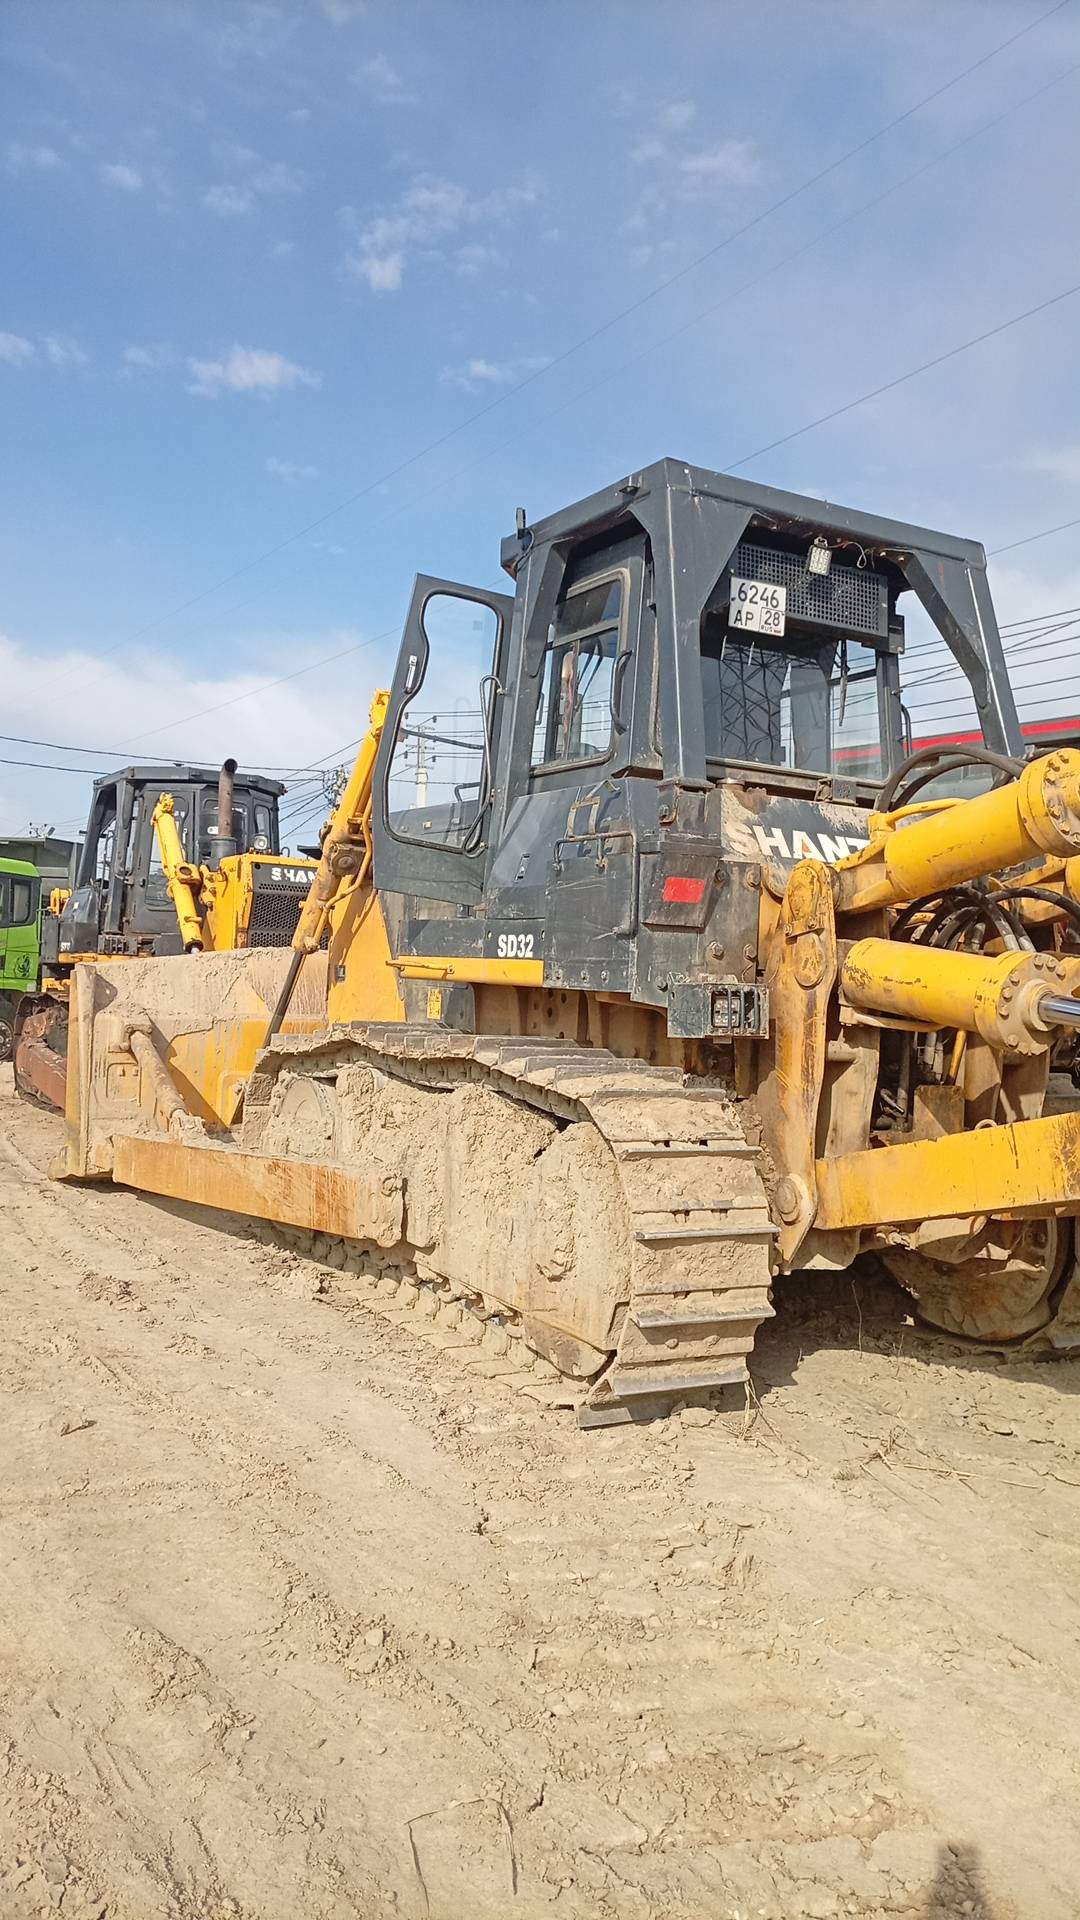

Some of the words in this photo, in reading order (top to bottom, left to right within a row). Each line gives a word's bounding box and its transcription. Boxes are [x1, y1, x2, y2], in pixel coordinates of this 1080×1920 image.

[738, 582, 779, 608] 6246
[764, 610, 780, 626] 28
[497, 933, 534, 958] SD32
